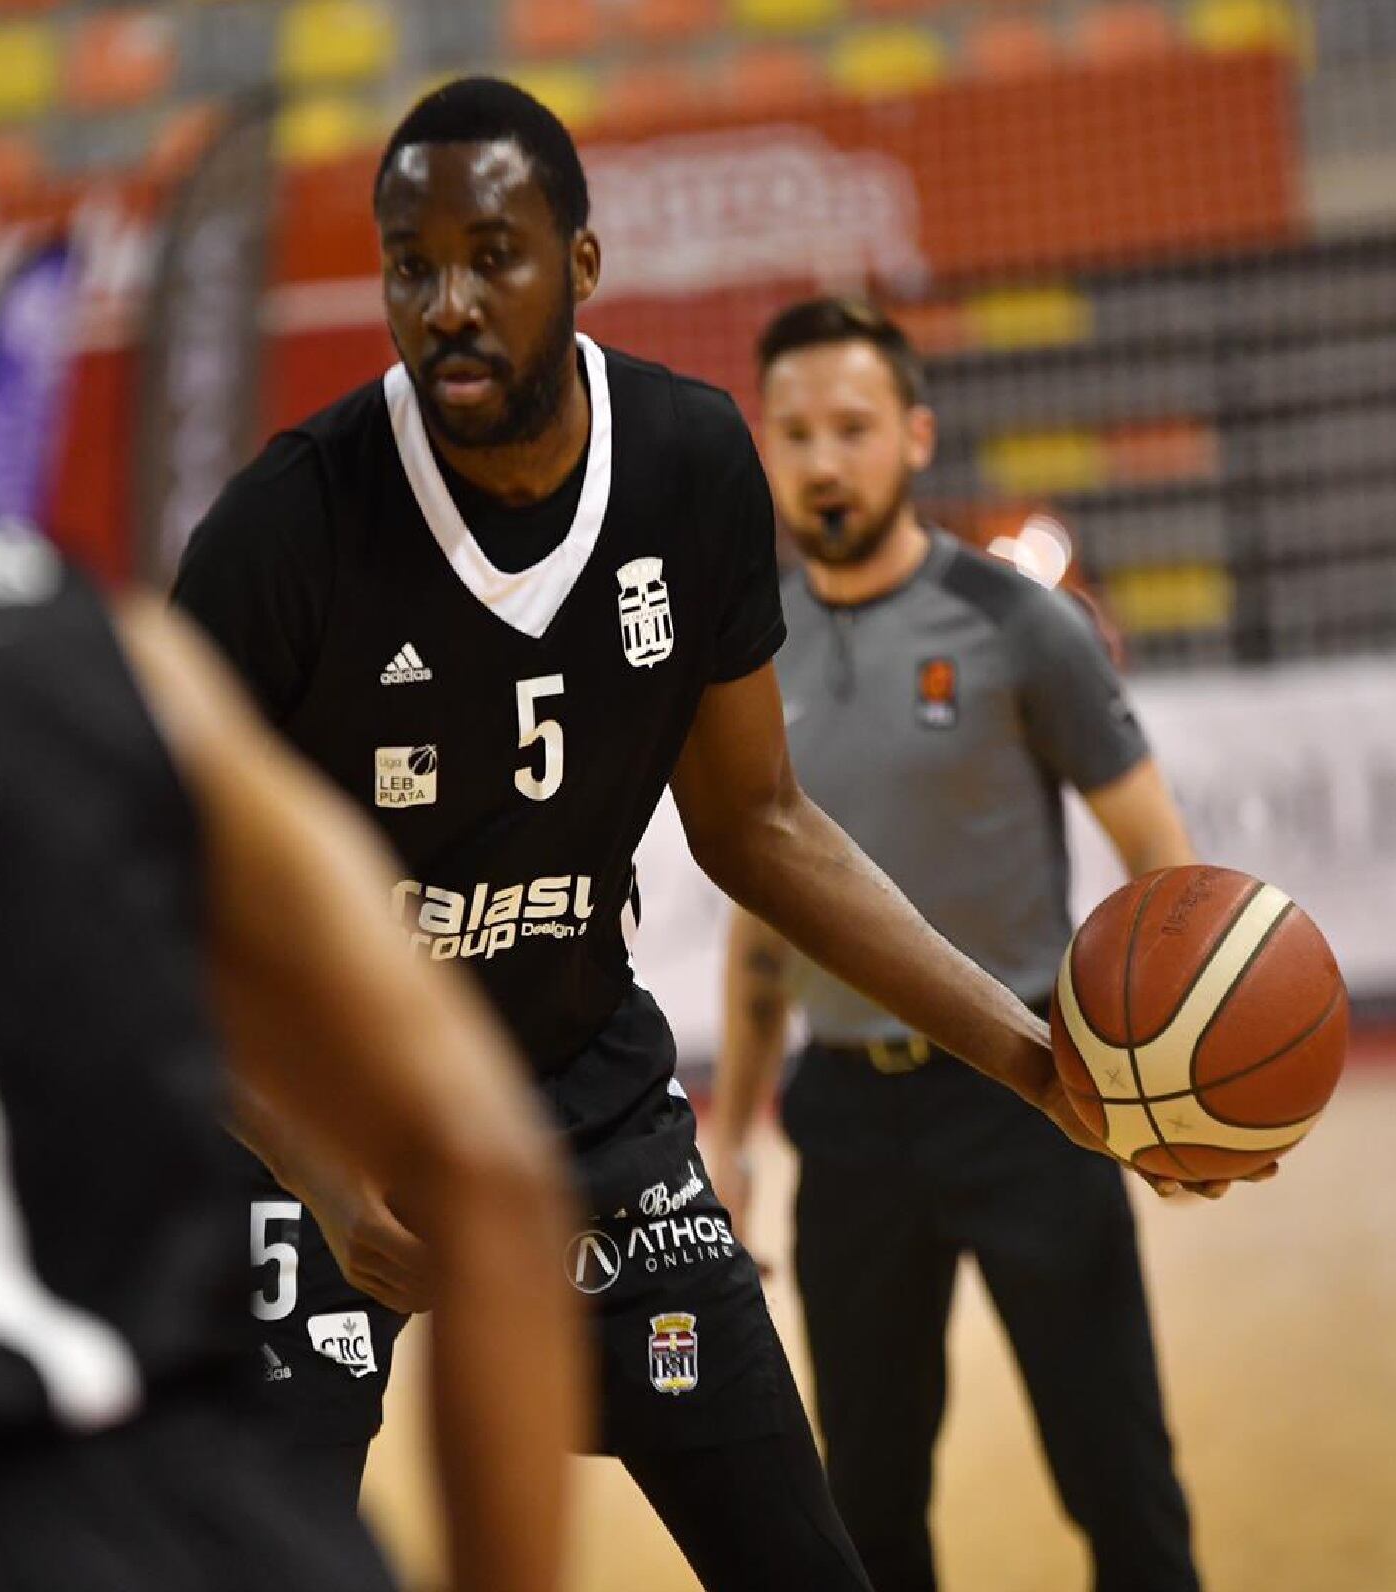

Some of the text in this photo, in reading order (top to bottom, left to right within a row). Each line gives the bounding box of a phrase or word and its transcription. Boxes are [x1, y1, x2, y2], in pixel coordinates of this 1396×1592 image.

[380, 667, 433, 685] adidas
[514, 674, 564, 801] 5
[379, 790, 426, 804] PLATA
[380, 776, 415, 790] LEB
[409, 922, 516, 960] roup
[521, 921, 574, 939] Design
[627, 1216, 735, 1259] ATHOS
[250, 1201, 302, 1321] 5
[645, 1246, 733, 1273] ONLINE
